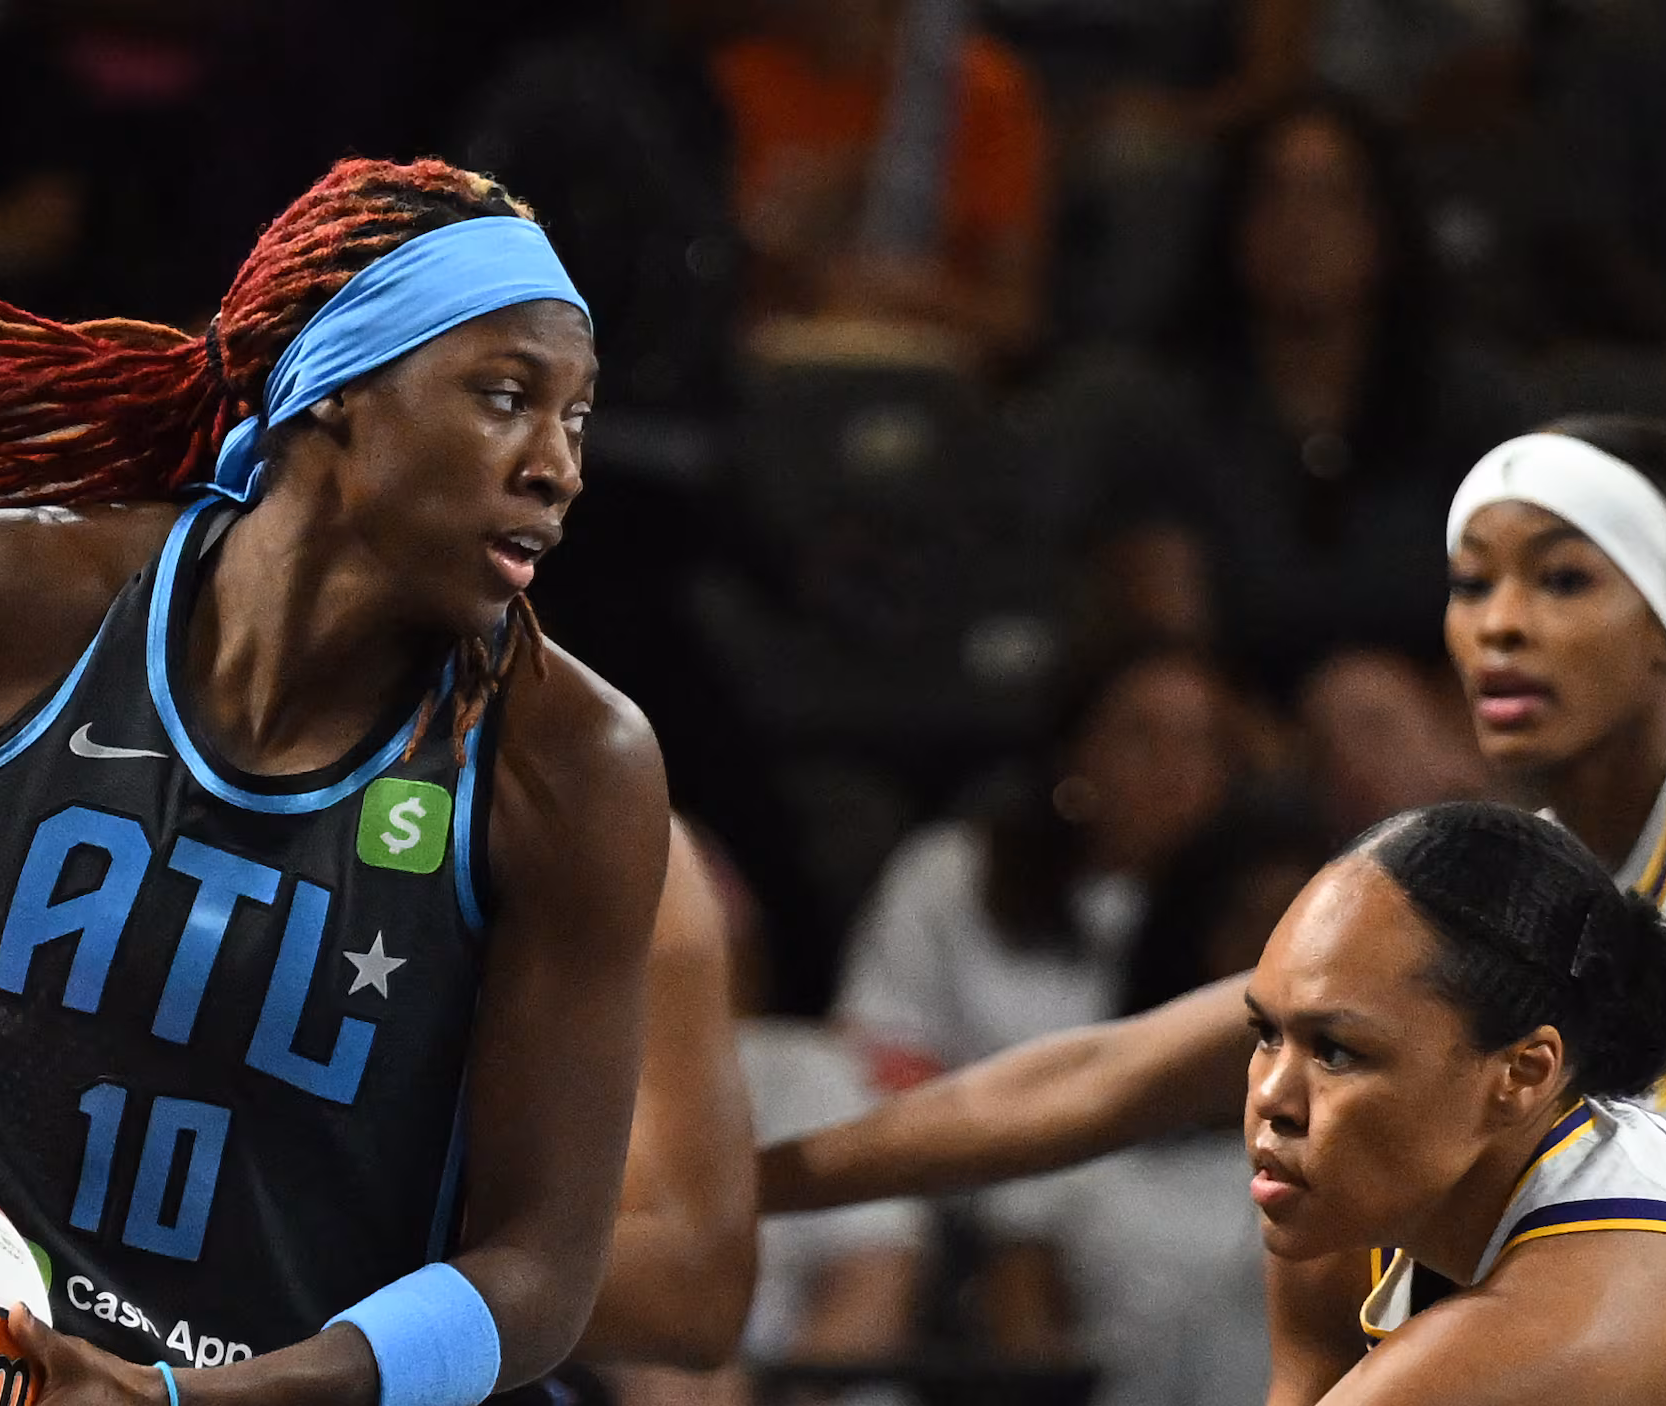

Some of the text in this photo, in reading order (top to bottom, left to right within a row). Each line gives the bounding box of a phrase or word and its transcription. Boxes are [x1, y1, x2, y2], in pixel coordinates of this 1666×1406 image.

[69, 1082, 232, 1263] 10
[66, 1275, 254, 1369] Cash App
